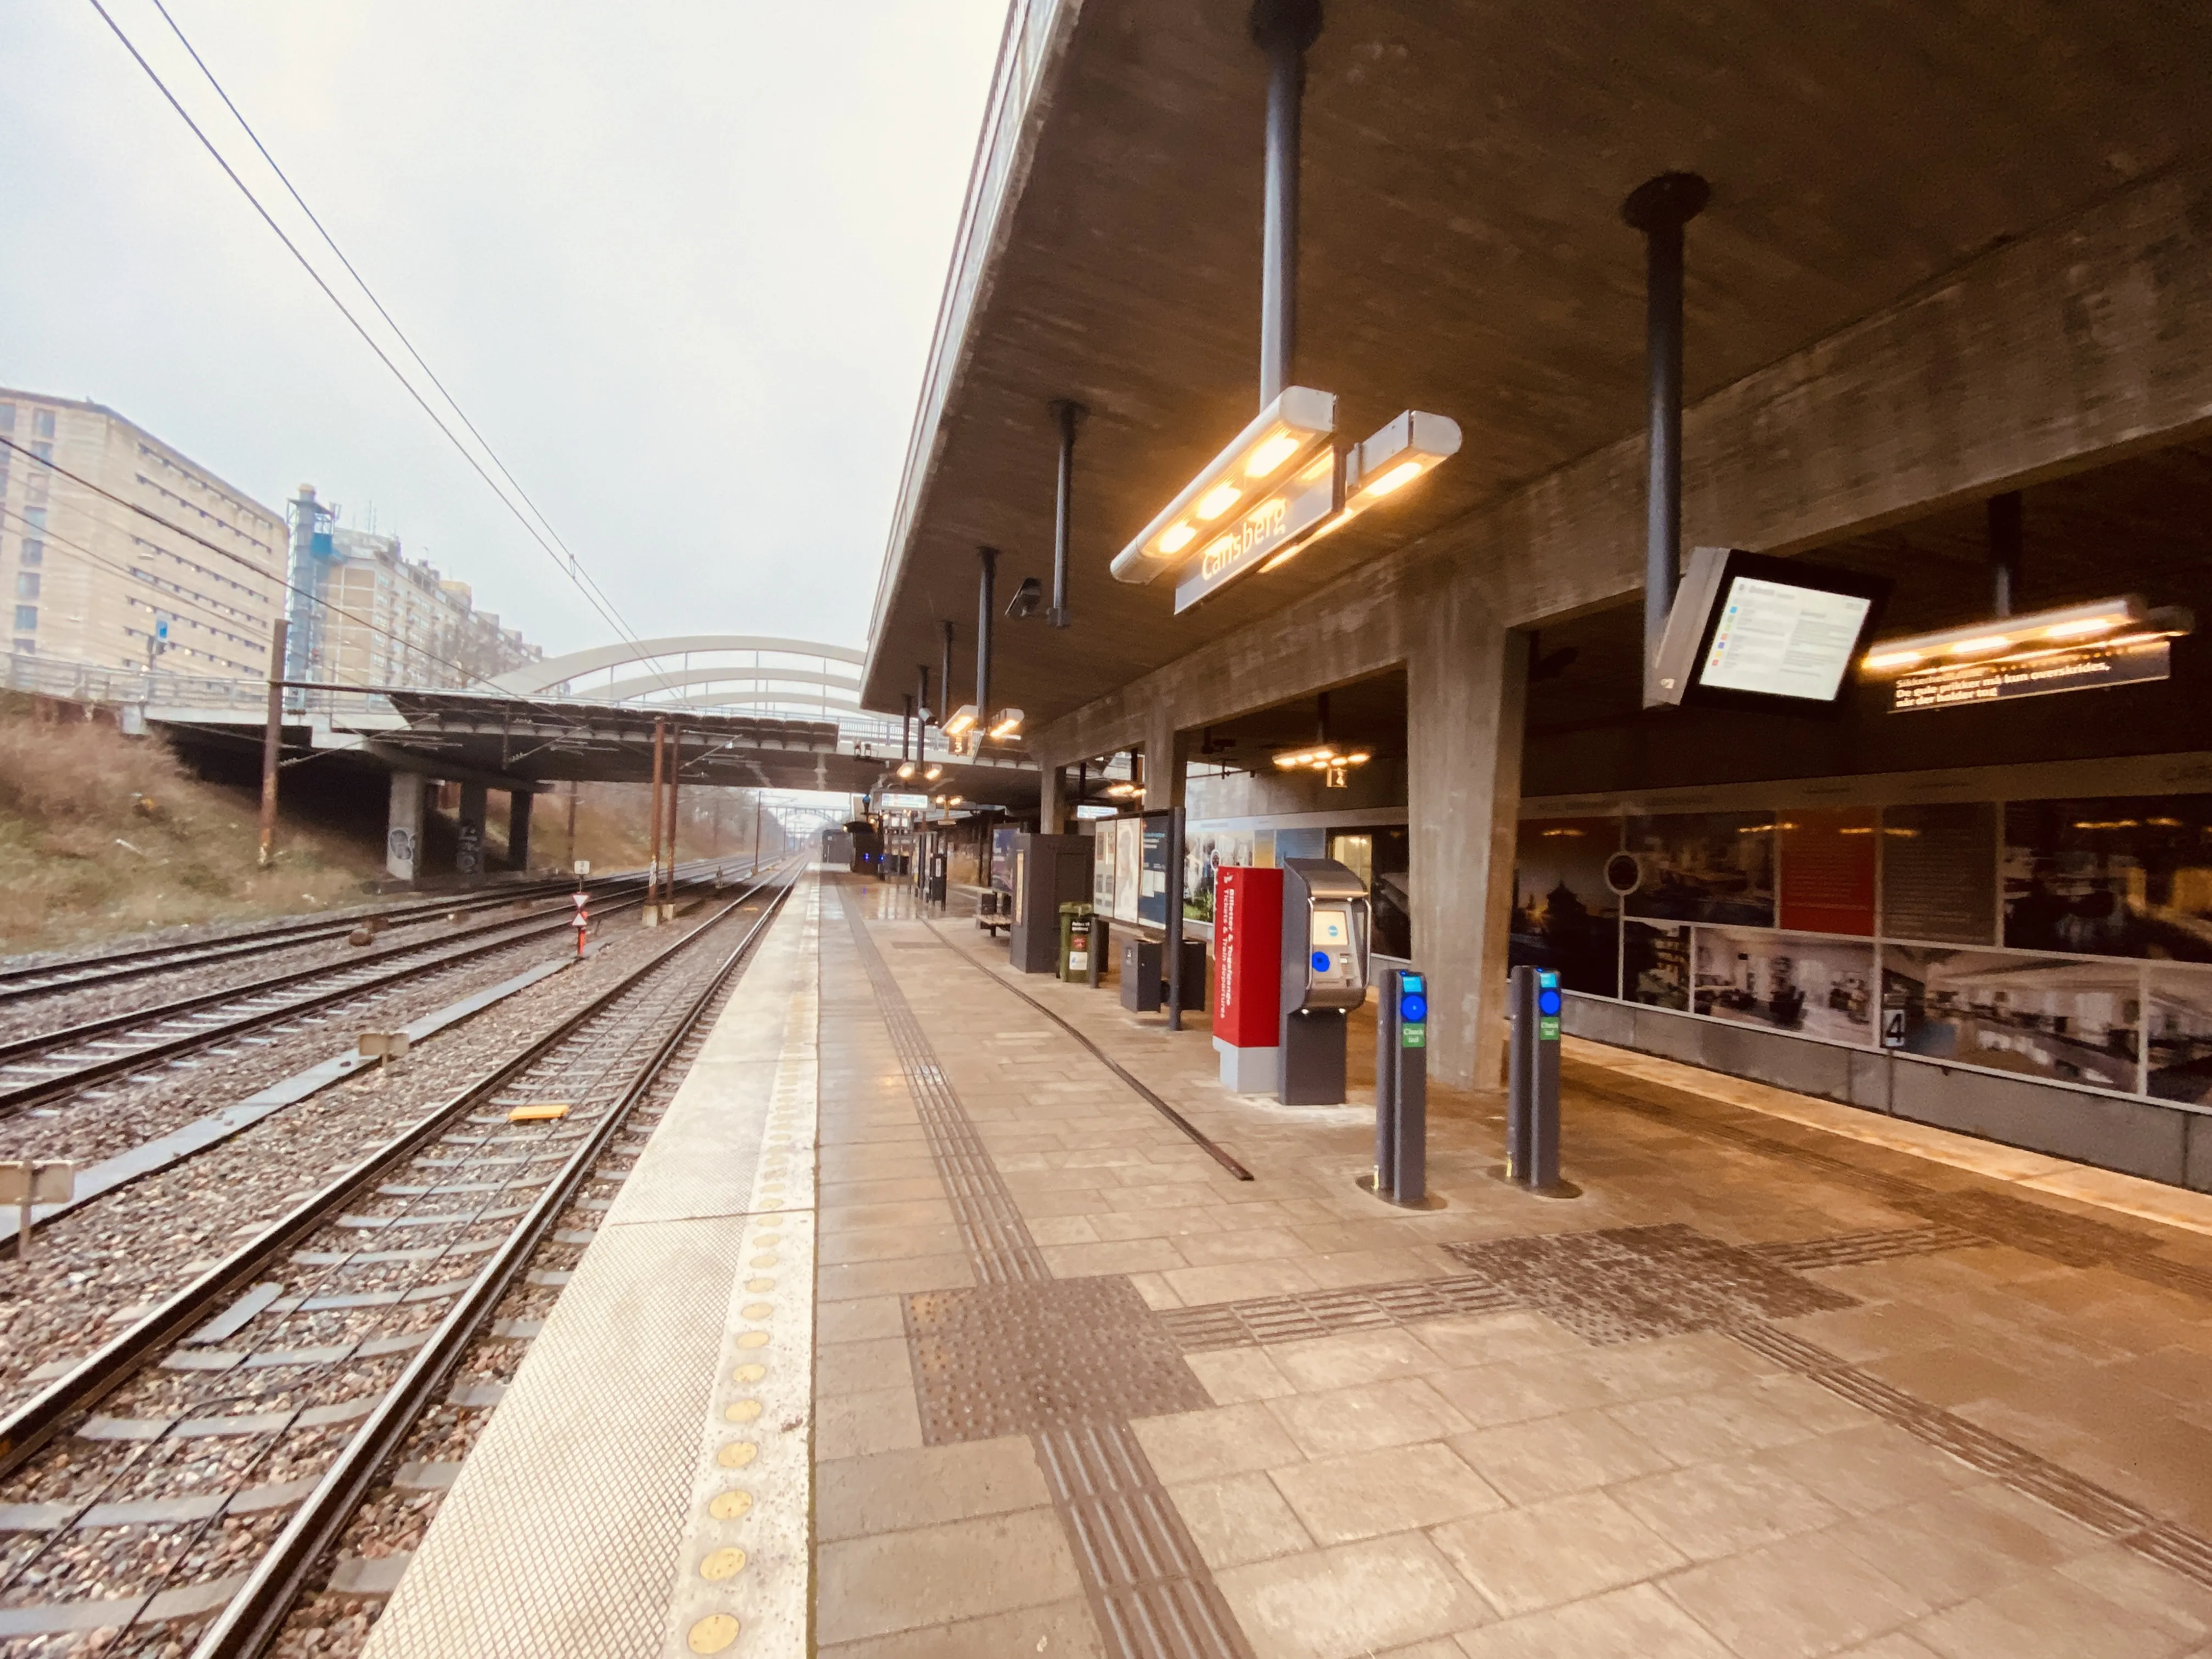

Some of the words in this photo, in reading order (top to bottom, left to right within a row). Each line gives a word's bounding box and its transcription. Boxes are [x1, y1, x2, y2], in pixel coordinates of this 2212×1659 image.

[1201, 498, 1286, 580] Carlsberg
[1896, 689, 1911, 698] De
[1914, 686, 1938, 697] gule
[1939, 680, 1981, 694] prikker
[1983, 675, 2002, 686] må
[2004, 674, 2029, 683] kun
[1915, 696, 1935, 705] der
[1937, 691, 1976, 702] holder
[954, 742, 962, 753] 3
[1222, 926, 1228, 934] &
[1887, 1013, 1905, 1043] 4
